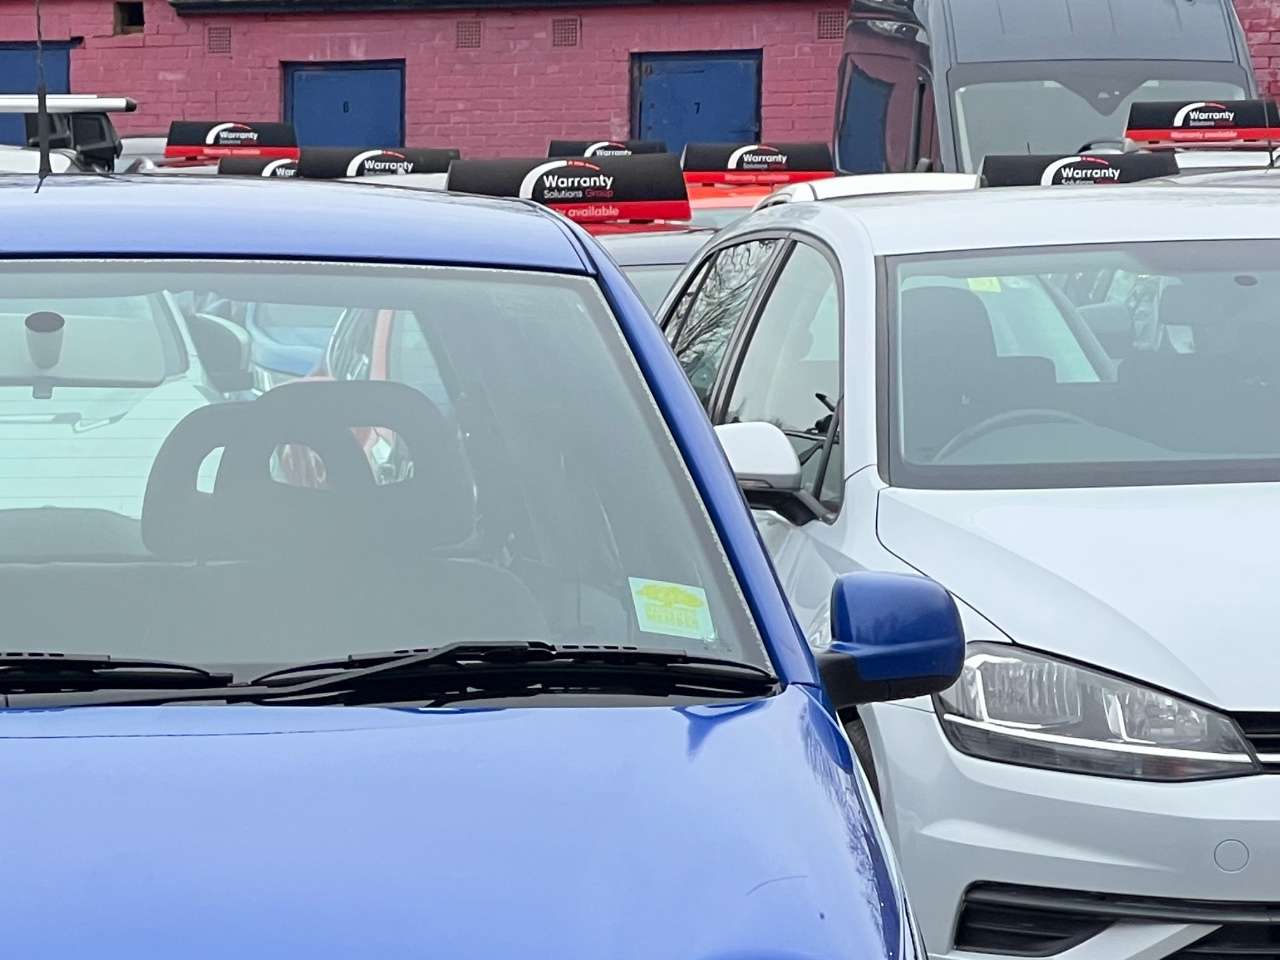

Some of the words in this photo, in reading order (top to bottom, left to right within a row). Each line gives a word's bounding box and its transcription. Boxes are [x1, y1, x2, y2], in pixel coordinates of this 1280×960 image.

[694, 102, 701, 114] 7
[1189, 111, 1235, 121] Warranty
[219, 131, 258, 140] Warranty
[743, 154, 788, 164] Warranty
[364, 160, 414, 171] Warranty
[1061, 167, 1120, 180] Warranty
[543, 174, 614, 190] Warranty
[543, 189, 583, 199] Solutions
[584, 189, 614, 198] Group
[567, 206, 620, 217] available
